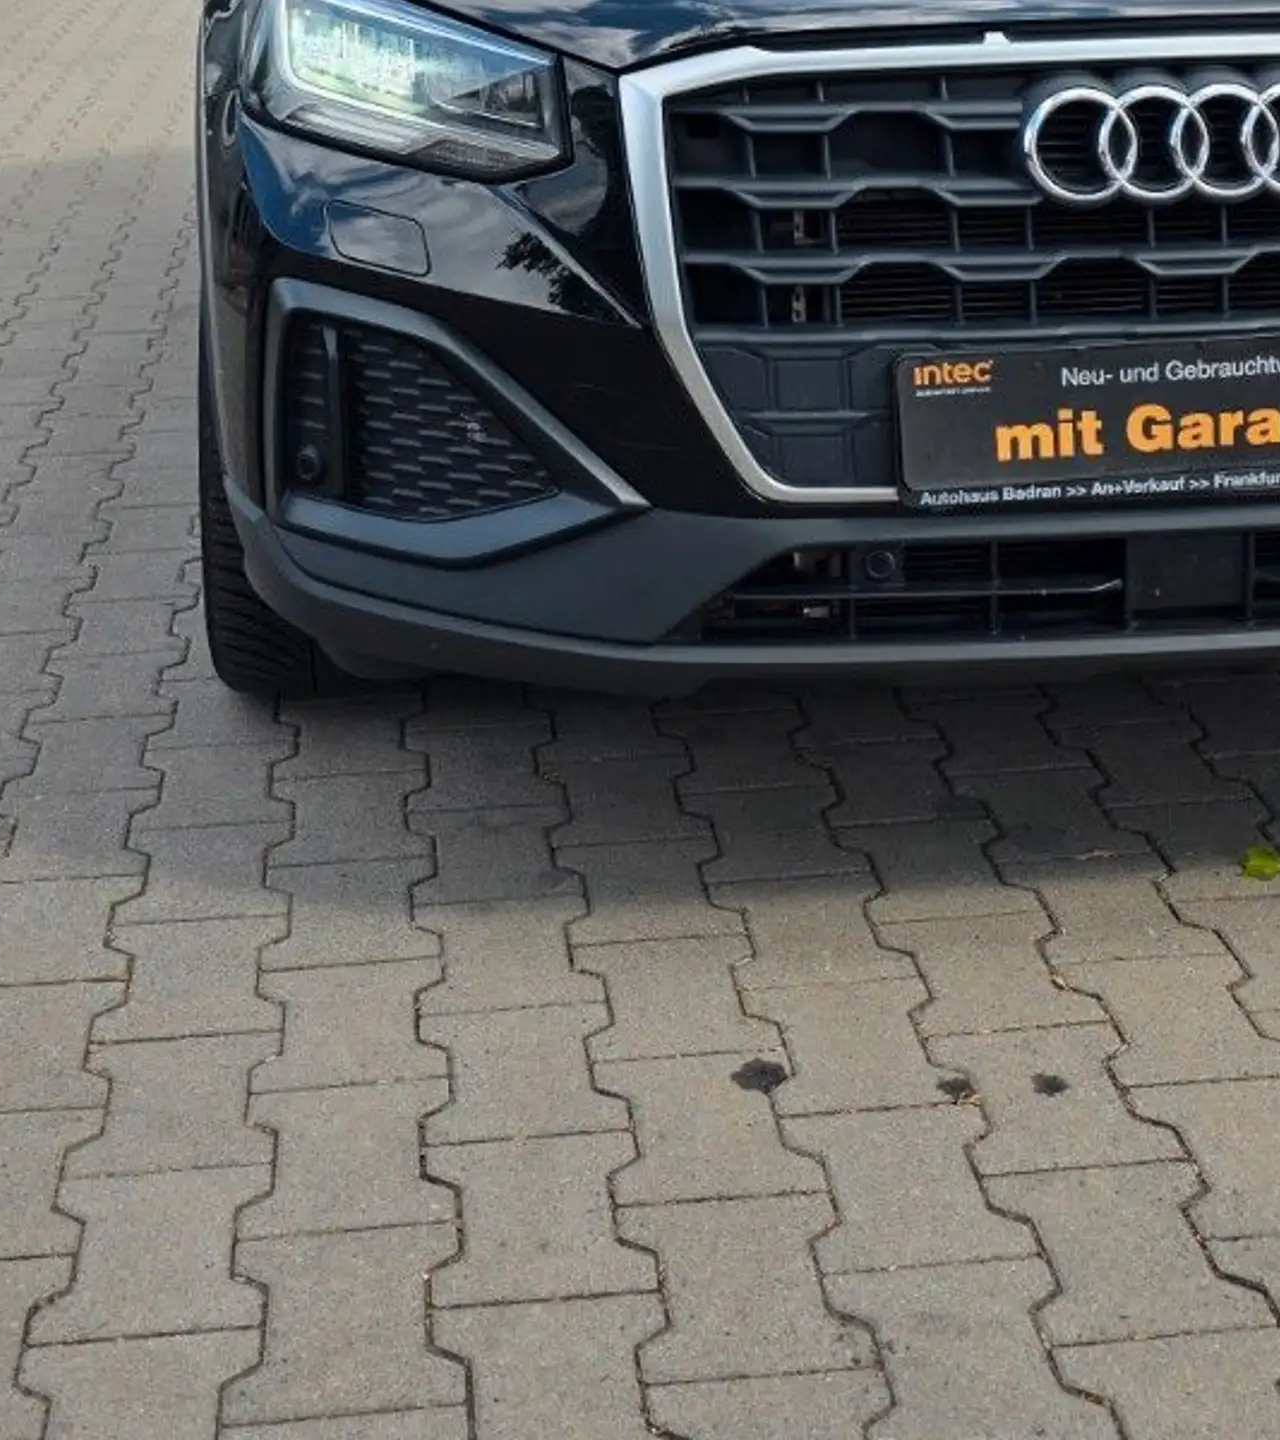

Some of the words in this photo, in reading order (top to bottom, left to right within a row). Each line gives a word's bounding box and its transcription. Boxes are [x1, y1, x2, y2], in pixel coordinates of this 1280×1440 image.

[913, 360, 993, 386] intec
[1061, 367, 1113, 387] Neu-
[1119, 362, 1160, 384] und
[995, 408, 1104, 462] mit
[920, 489, 999, 507] Autohaus
